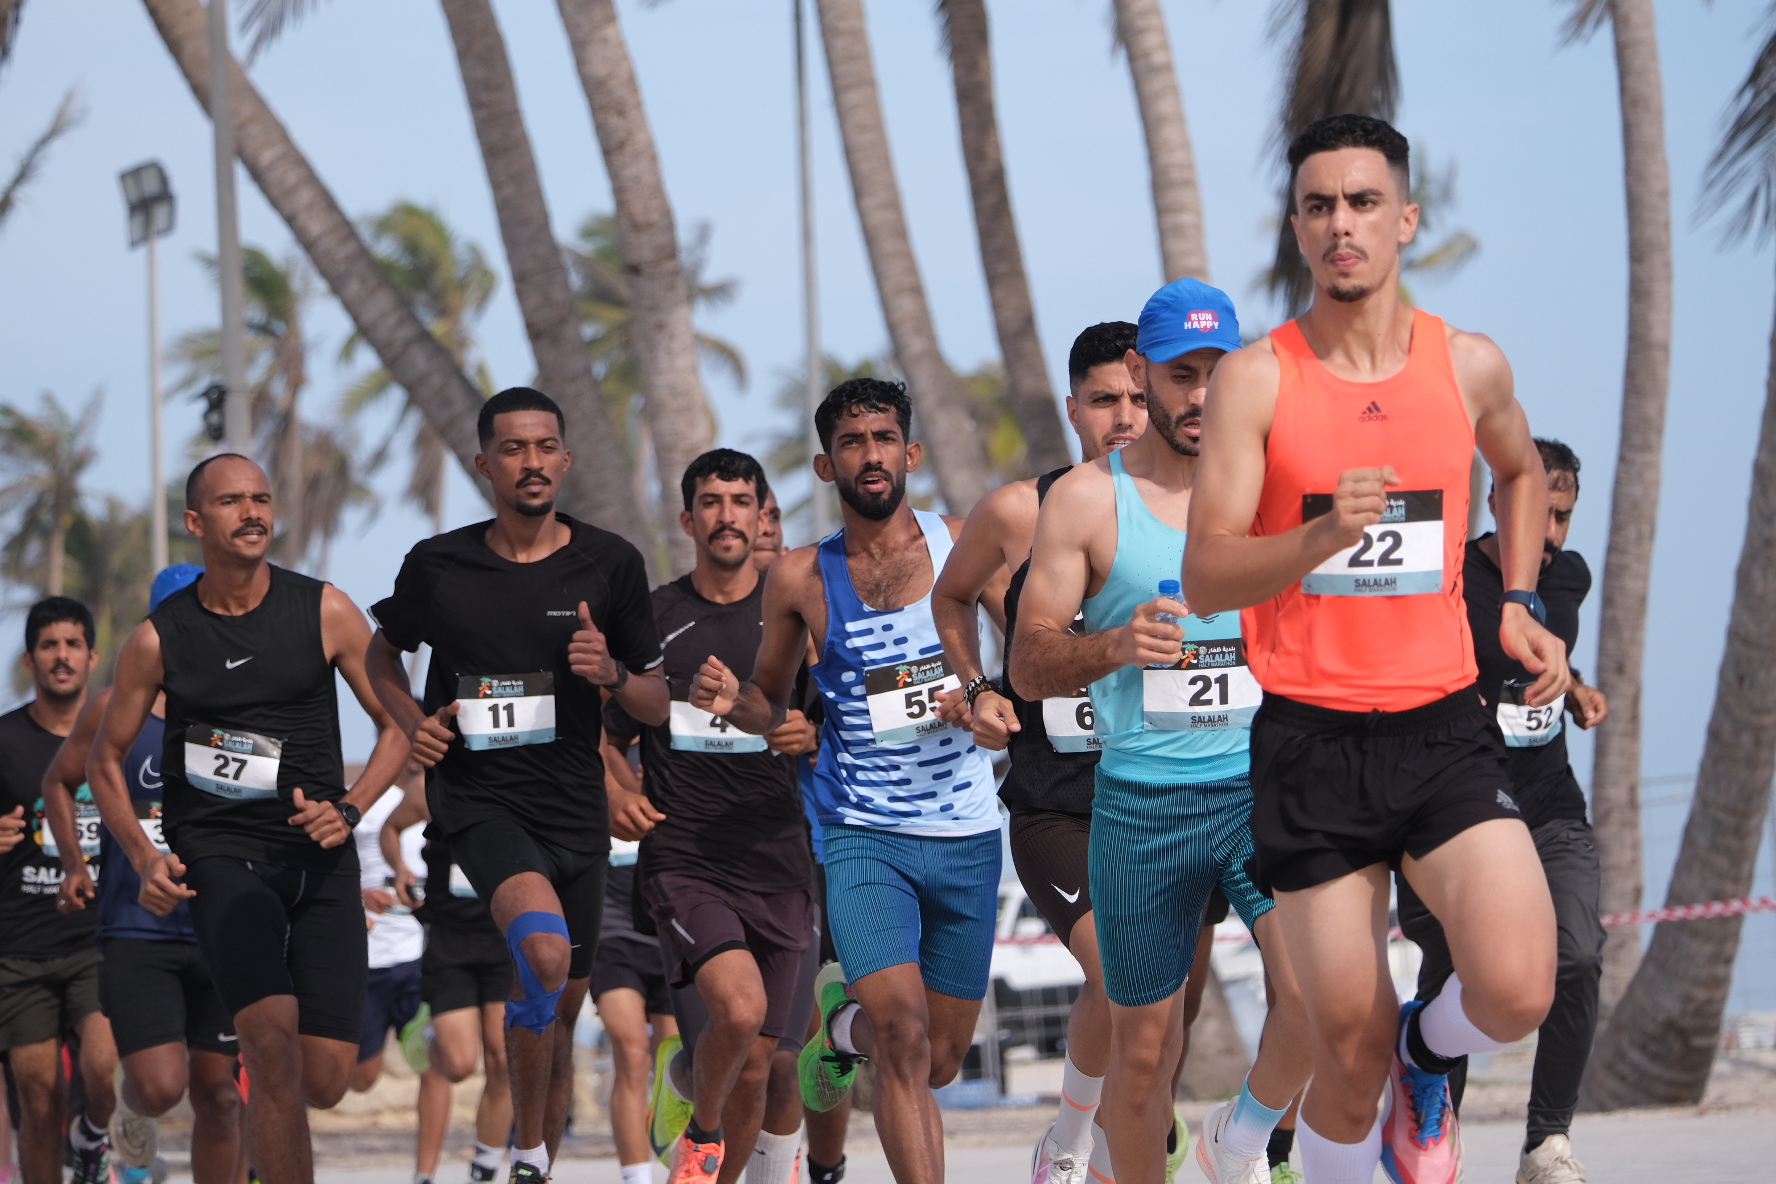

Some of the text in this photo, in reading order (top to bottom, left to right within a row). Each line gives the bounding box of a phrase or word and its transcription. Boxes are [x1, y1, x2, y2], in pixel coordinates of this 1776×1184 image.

[1184, 321, 1219, 329] HAPPY
[1359, 414, 1387, 422] adidas
[1348, 530, 1404, 568] 22
[1354, 577, 1397, 588] SALALAH
[1199, 653, 1236, 663] SALALAH
[912, 666, 944, 681] SALALAH
[1188, 673, 1229, 706] 21
[488, 703, 515, 728] 11
[1191, 714, 1228, 724] SALALAH
[1526, 706, 1553, 731] 52
[709, 715, 729, 732] 4
[488, 735, 519, 743] SALALAH
[1086, 738, 1102, 746] SAL
[214, 754, 248, 780] 27
